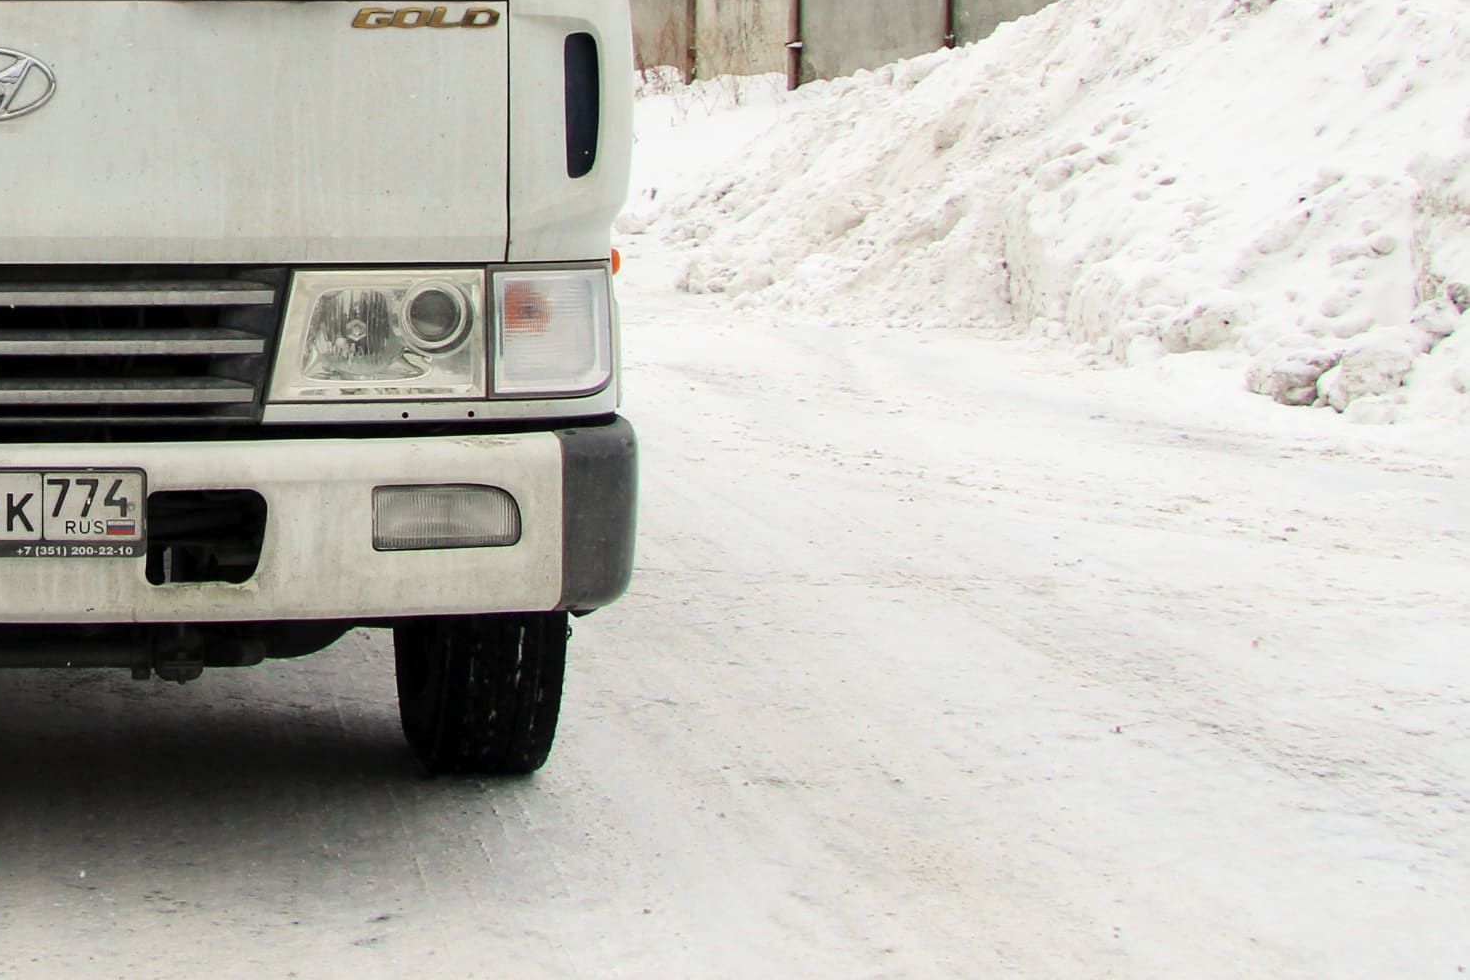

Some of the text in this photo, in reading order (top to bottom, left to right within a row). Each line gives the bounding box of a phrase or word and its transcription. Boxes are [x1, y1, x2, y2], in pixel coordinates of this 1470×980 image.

[351, 6, 501, 28] GOLD
[46, 479, 128, 518] 774
[65, 521, 104, 534] RUS
[16, 546, 32, 556] +7
[35, 545, 67, 556] (351)
[71, 546, 134, 556] 200-22-10
